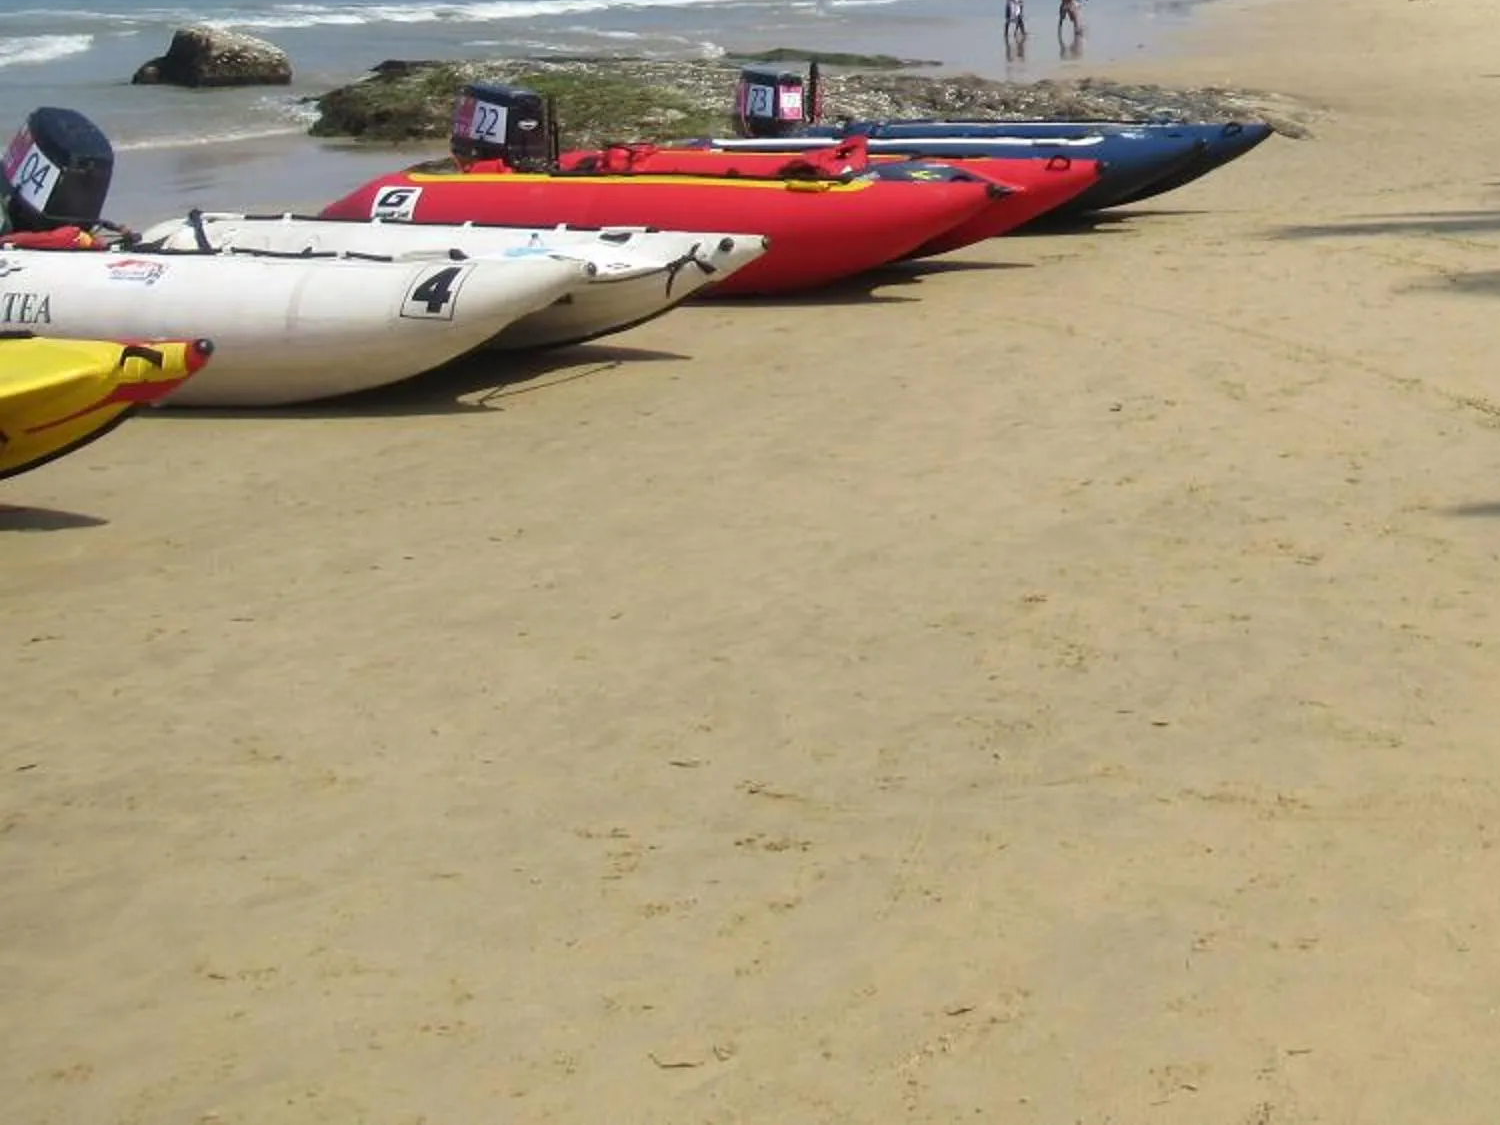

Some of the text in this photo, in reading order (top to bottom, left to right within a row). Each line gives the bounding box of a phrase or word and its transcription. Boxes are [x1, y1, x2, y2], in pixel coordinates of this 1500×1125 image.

[475, 106, 499, 136] 22
[412, 266, 462, 313] 4
[3, 292, 51, 324] TEA
